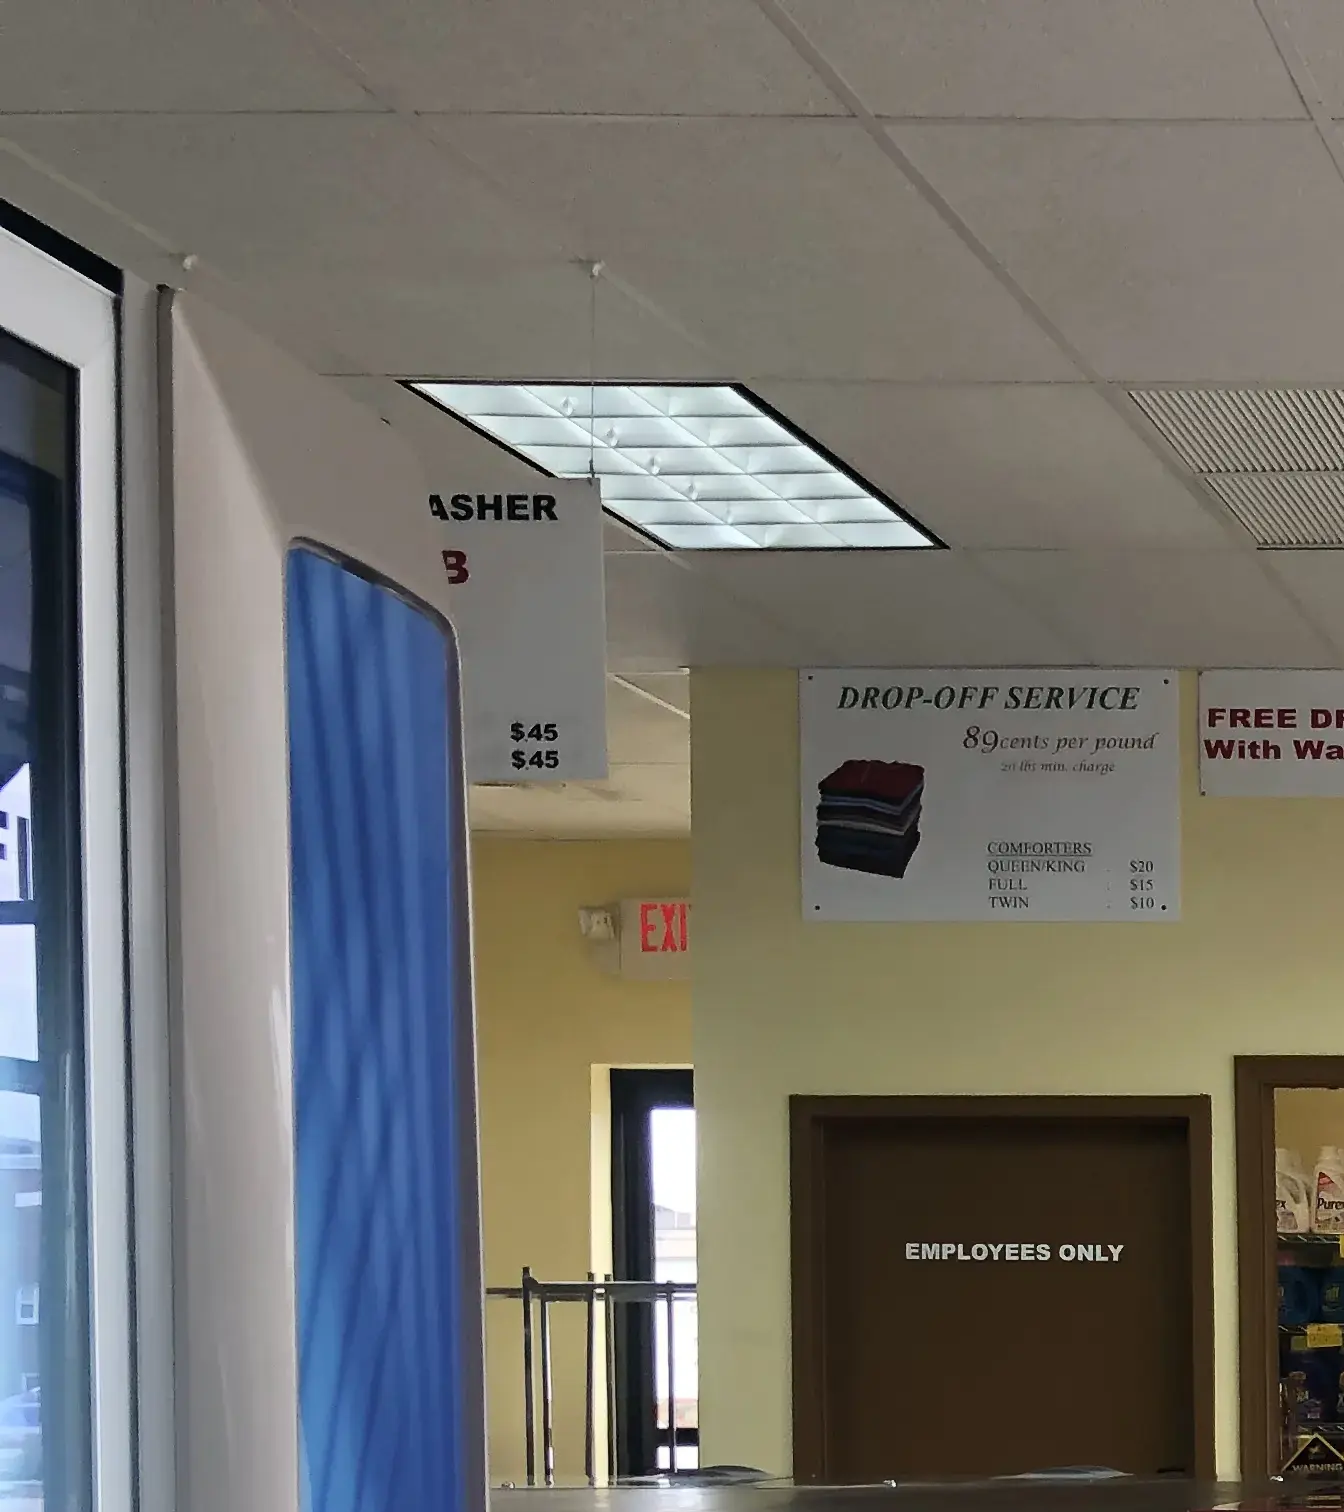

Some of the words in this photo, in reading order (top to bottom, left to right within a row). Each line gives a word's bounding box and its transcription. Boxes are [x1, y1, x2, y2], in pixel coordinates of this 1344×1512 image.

[837, 686, 999, 710] DROP-OFF
[1004, 686, 1141, 710] SERVICE
[1208, 708, 1297, 728] FREE
[1053, 736, 1088, 754] per
[1092, 732, 1159, 754] pound
[1204, 739, 1281, 759] With
[1072, 760, 1117, 776] charge
[987, 842, 1093, 855] COMFORTERS
[987, 860, 1085, 873] QUEEN/KING
[1130, 860, 1154, 873] $20
[988, 878, 1027, 891] FULL
[1130, 879, 1154, 891] $15
[988, 896, 1029, 909] TWIN
[1130, 896, 1155, 910] $10
[640, 903, 691, 952] EXI
[905, 1243, 1051, 1261] EMPLOYEES
[1058, 1244, 1125, 1261] ONLY
[1292, 1463, 1343, 1471] WARNING
